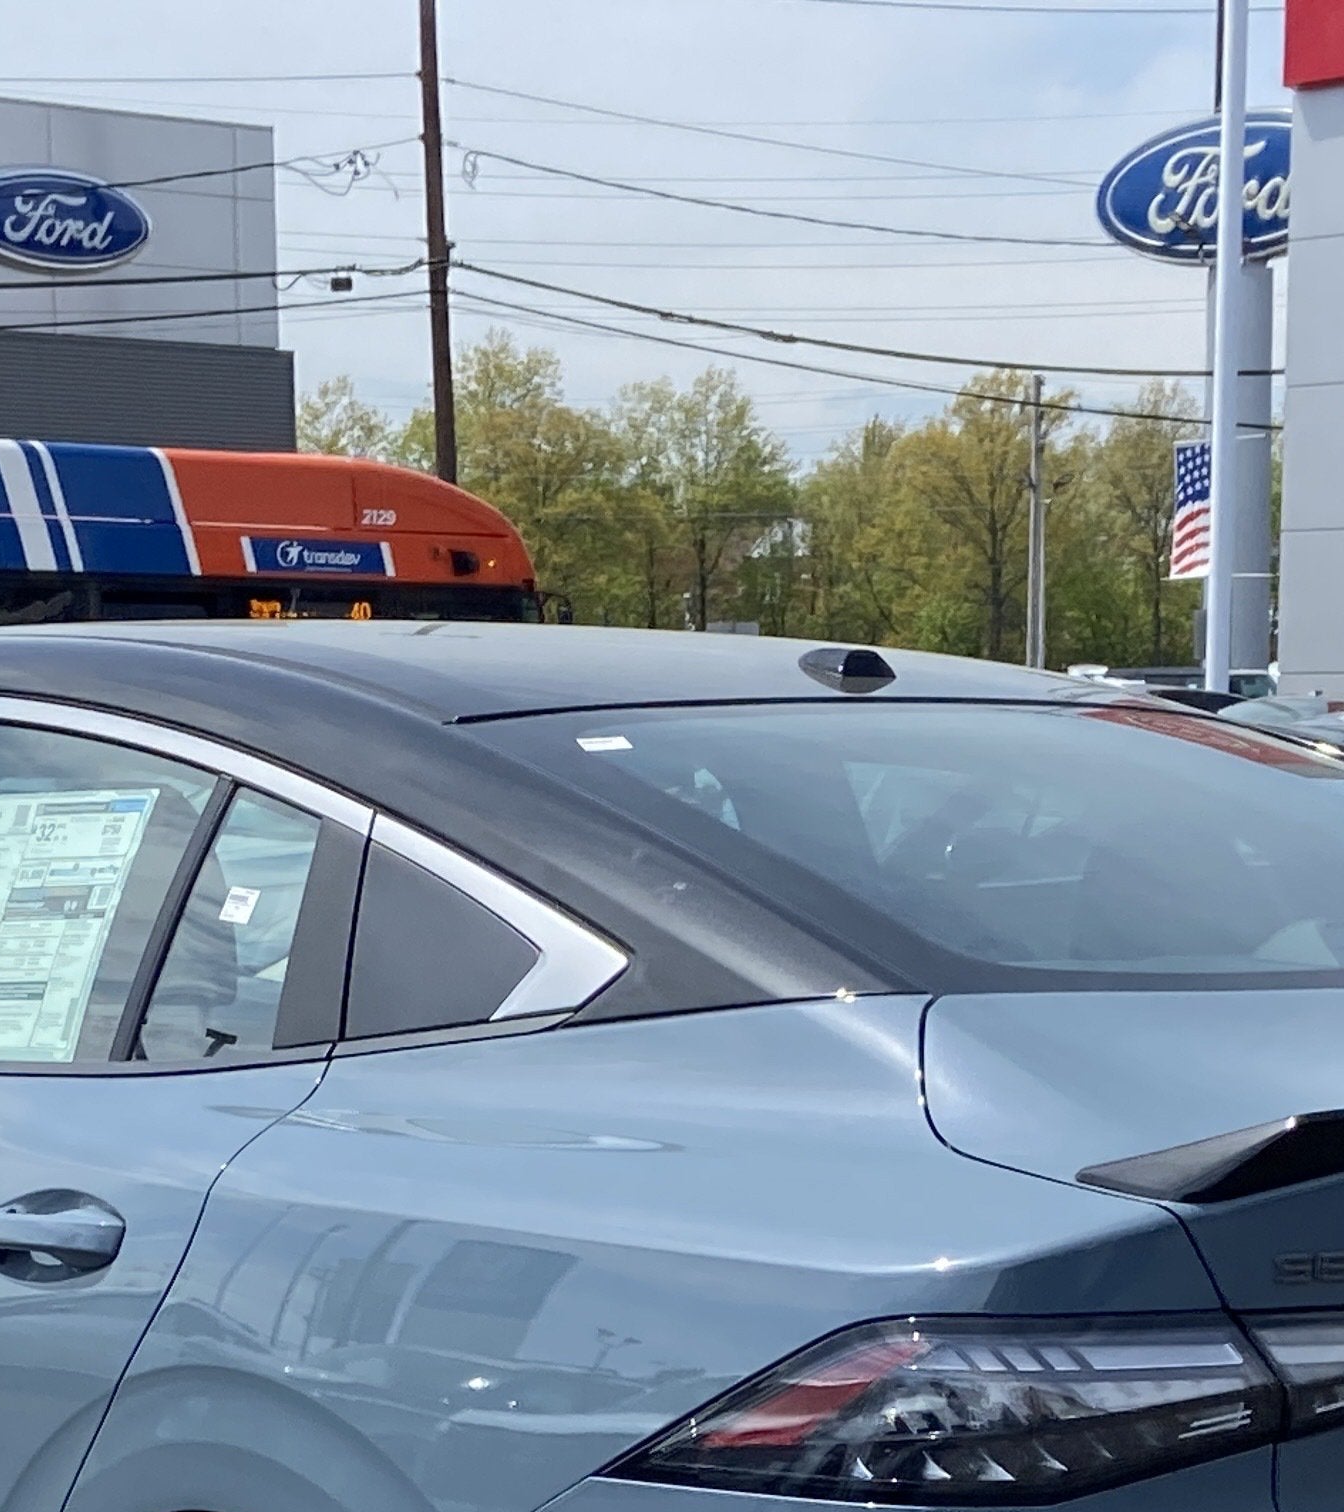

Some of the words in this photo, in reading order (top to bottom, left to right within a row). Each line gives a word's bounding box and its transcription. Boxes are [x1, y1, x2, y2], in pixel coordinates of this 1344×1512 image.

[3, 188, 115, 250] Ford
[360, 509, 397, 525] 2129
[302, 549, 361, 566] transdev
